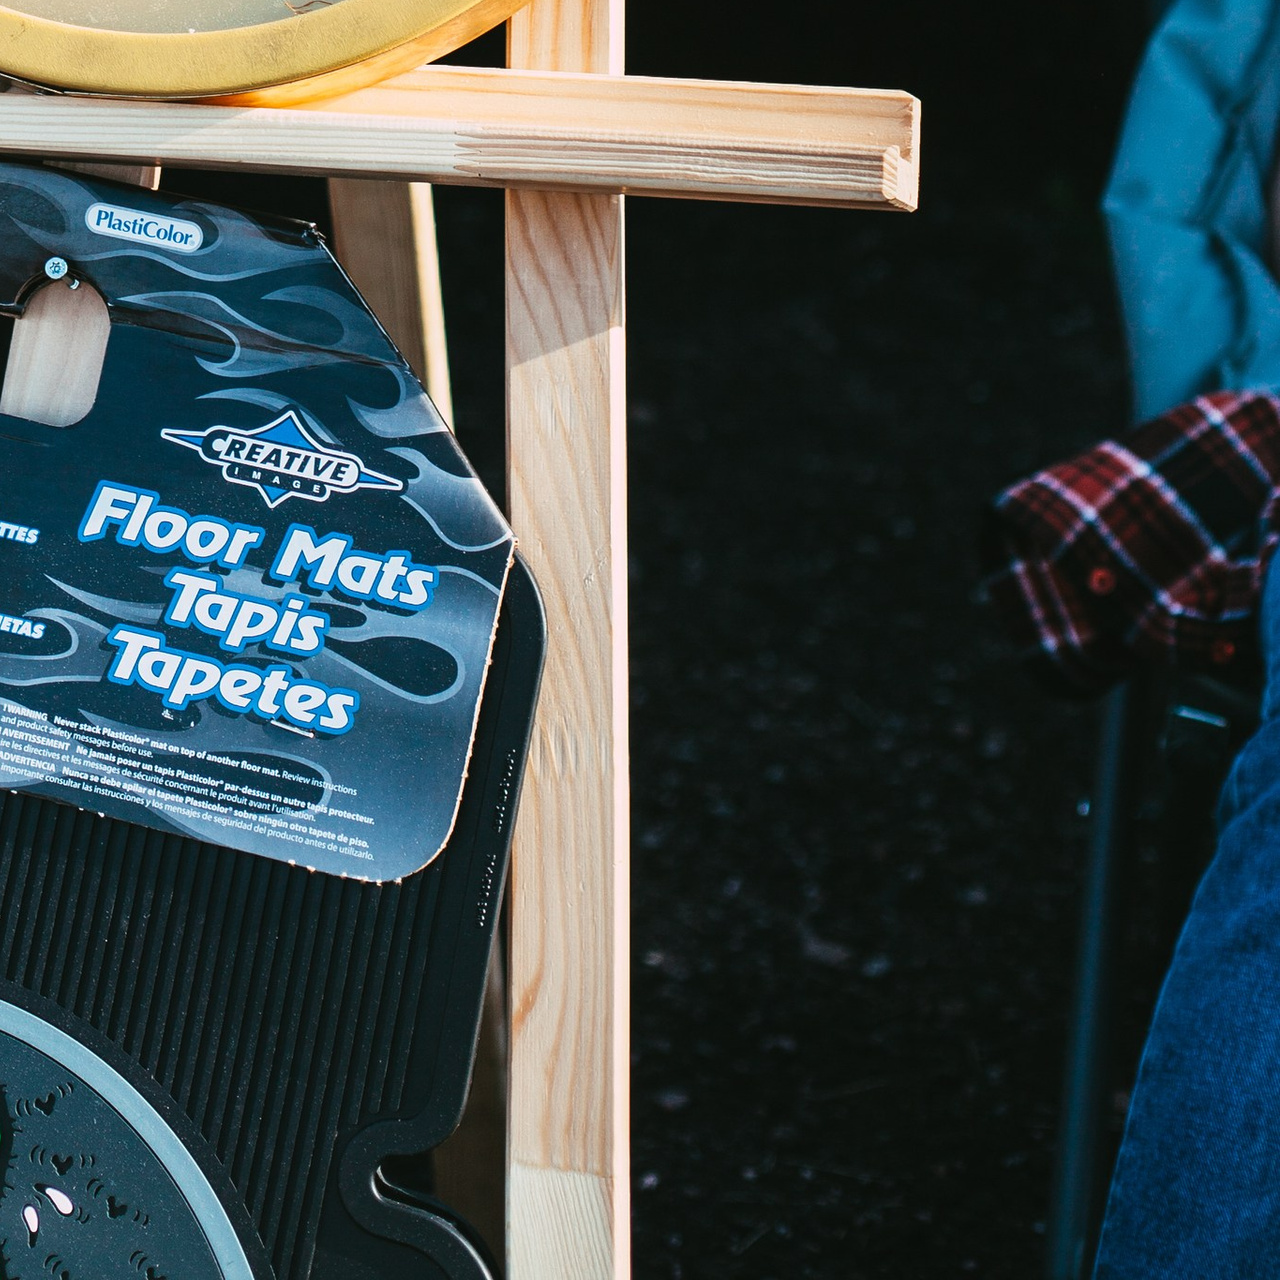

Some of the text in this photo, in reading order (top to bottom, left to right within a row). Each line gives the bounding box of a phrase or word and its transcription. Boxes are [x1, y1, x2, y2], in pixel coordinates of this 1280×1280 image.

[95, 209, 193, 245] PlastiColor
[202, 430, 350, 482] CREATIVE
[234, 466, 321, 494] IMAGE
[81, 484, 435, 607] Floor Mats
[168, 570, 327, 653] Tapis
[112, 627, 356, 730] Tapetes
[0, 715, 154, 758] and product safety messages before use.
[2, 728, 71, 751] AVERTISSEMENT
[76, 745, 88, 756] Ne
[87, 748, 116, 762] jamais
[116, 757, 141, 768] poser
[141, 763, 153, 772] un
[154, 764, 175, 777] tapis
[270, 794, 282, 803] un
[282, 797, 306, 808] autre
[307, 801, 328, 814] tapis
[328, 808, 375, 825] protecteur.
[8, 706, 48, 722] WARNING
[53, 716, 79, 729] Never
[78, 723, 102, 735] stack
[150, 740, 168, 751] mat
[168, 745, 180, 753] on
[180, 747, 196, 758] top
[196, 750, 207, 759] of
[206, 754, 240, 768] another
[240, 760, 262, 773] floor
[261, 767, 281, 778] mat.
[282, 770, 311, 784] Review
[311, 777, 357, 796] instructions
[11, 740, 23, 751] les
[23, 744, 60, 760] directives
[61, 754, 70, 762] et
[71, 755, 82, 765] les
[82, 760, 121, 775] messages
[121, 768, 132, 778] de
[132, 771, 164, 785] sécurité
[164, 779, 209, 797] concernant
[209, 788, 218, 798] le
[217, 792, 248, 806] produit
[248, 799, 271, 811] avant
[0, 762, 44, 781] importante
[44, 775, 82, 789] consultar
[81, 781, 93, 793] las
[93, 784, 145, 805] instrucciones
[144, 799, 151, 808] y
[151, 799, 163, 810] los
[164, 804, 201, 818] mensajes
[201, 811, 213, 821] de
[213, 816, 253, 831] seguridad
[253, 824, 267, 834] del
[267, 829, 304, 843] producto
[304, 838, 326, 849] antes
[327, 842, 338, 852] de
[339, 846, 374, 861] utilizarlo.
[62, 766, 89, 780] Nunca
[89, 774, 100, 783] se
[100, 775, 122, 788] debe
[122, 782, 147, 794] apilar
[147, 787, 157, 796] el
[156, 789, 184, 803] tapete
[233, 809, 258, 821] sobre
[258, 814, 289, 829] ningún
[289, 823, 308, 833] otro
[308, 826, 336, 840] tapete
[337, 833, 349, 843] de
[348, 837, 369, 848] piso.
